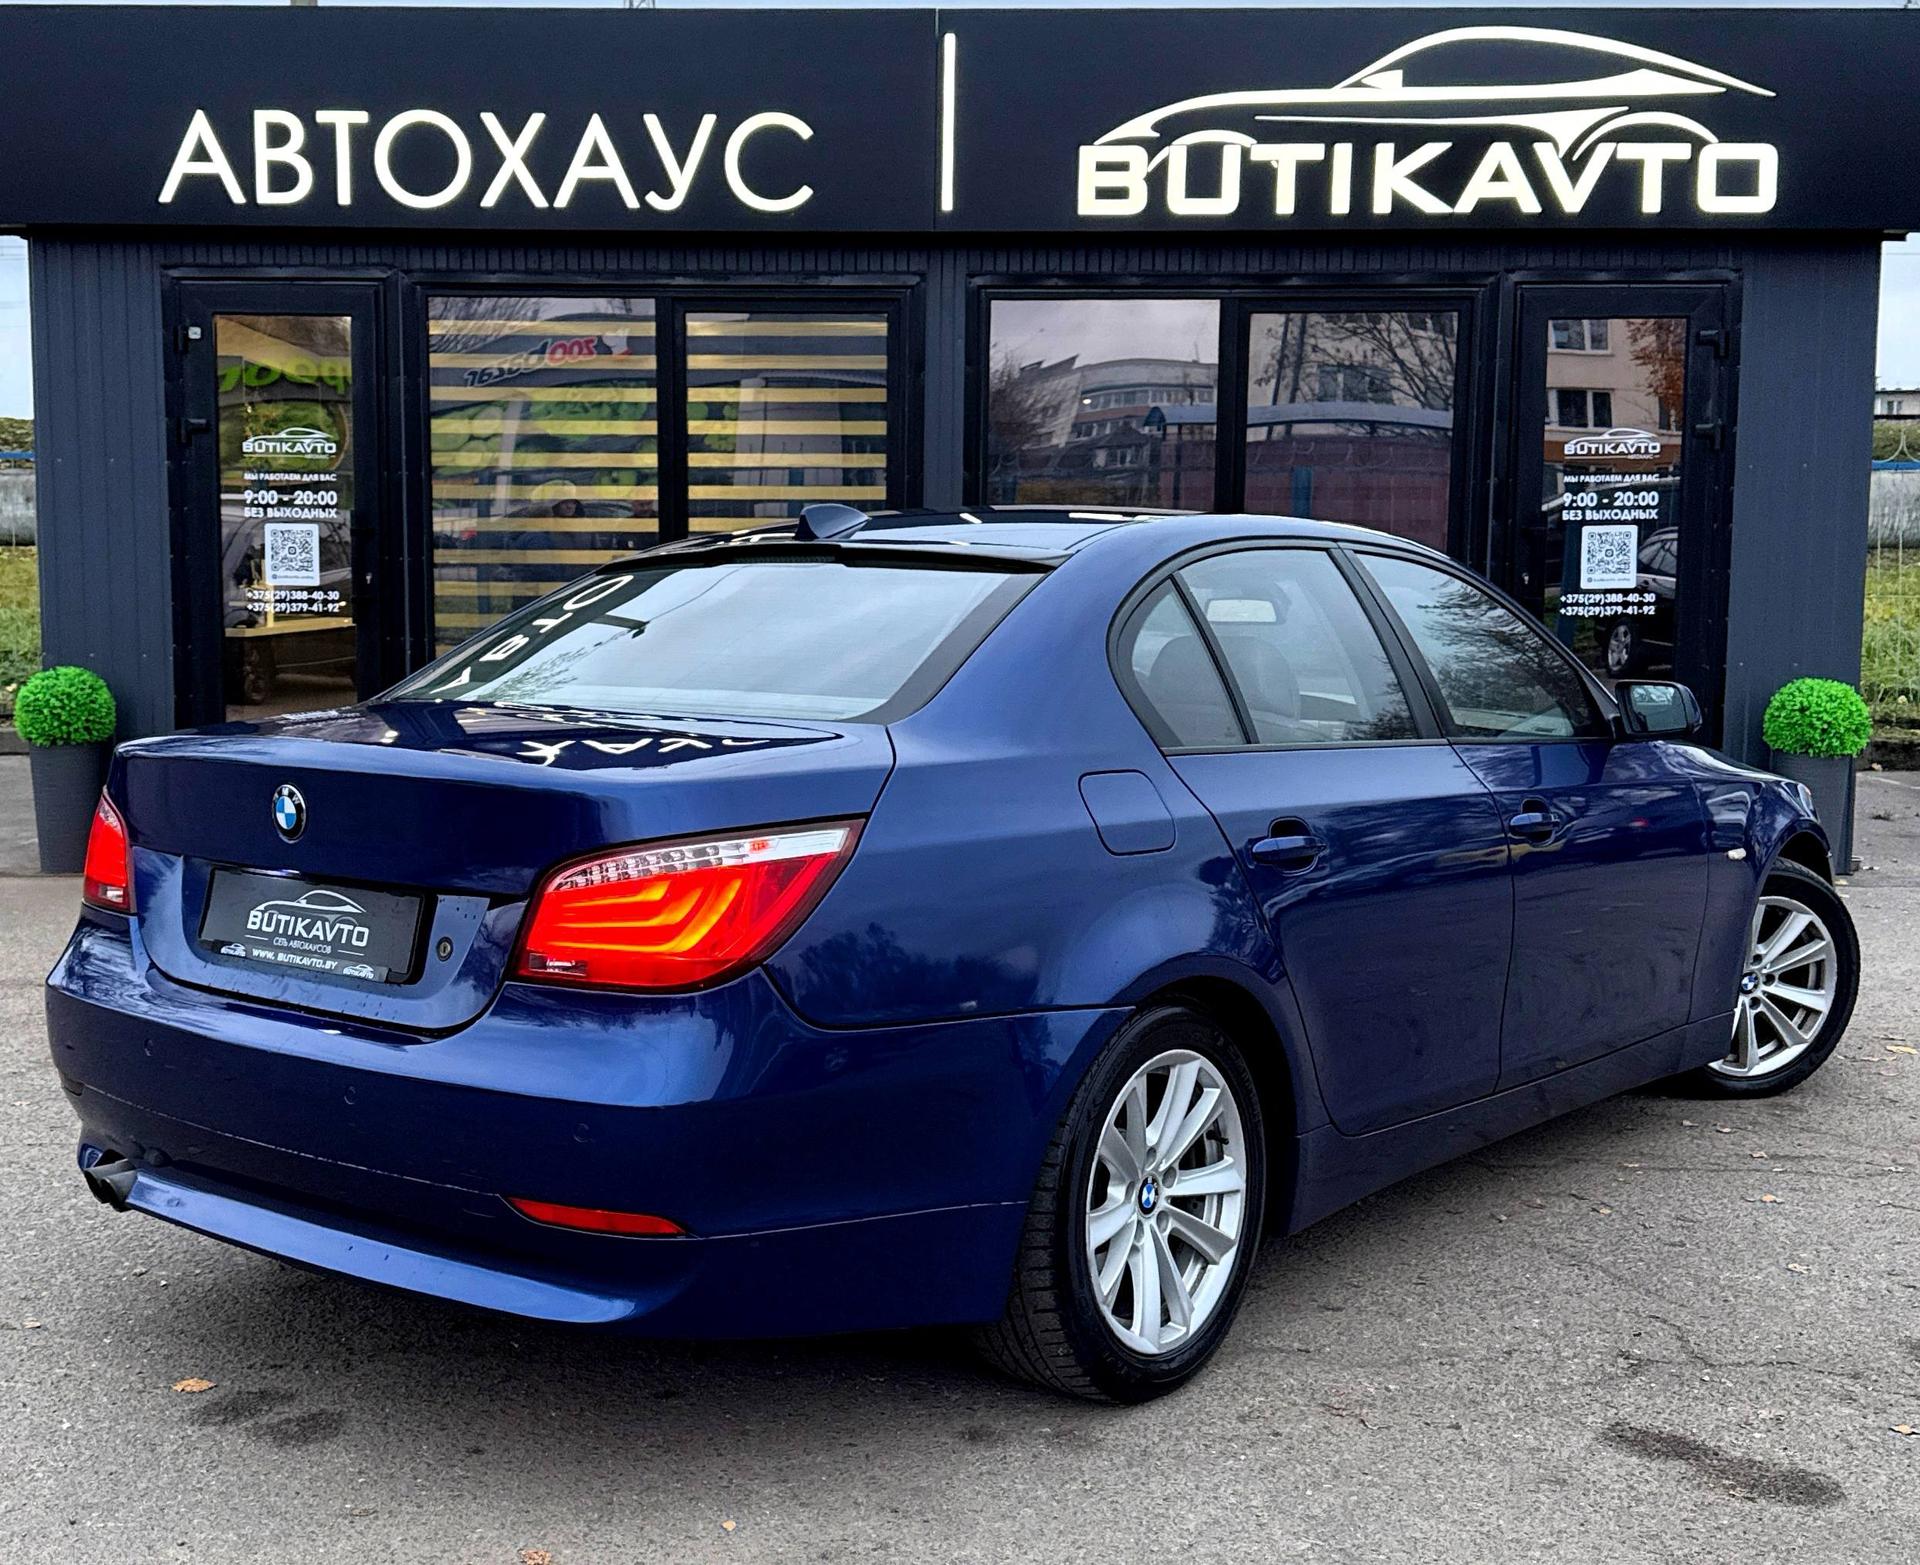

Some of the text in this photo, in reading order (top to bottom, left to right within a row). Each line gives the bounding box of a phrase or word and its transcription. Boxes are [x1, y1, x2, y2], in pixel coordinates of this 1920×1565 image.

[158, 109, 814, 213] АВТОХАУС
[1076, 140, 1779, 216] BUTIKAVTO
[242, 441, 337, 454] BUTIKAVTO
[1563, 443, 1661, 455] BUTIKAVTO
[1563, 473, 1660, 483] МЫ РАБОТАЕМ ДЛЯ ВАС
[243, 490, 279, 505] 9:00
[293, 491, 338, 505] 20:00
[1562, 492, 1598, 507] 9:00
[1613, 491, 1660, 507] 20:00
[244, 507, 338, 519] БЕЗ ВЫХОДНЫХ
[1561, 509, 1659, 521] БЕЗ ВЫХОДНЫХ
[246, 590, 340, 601] +375(29)388-40-30
[1560, 593, 1656, 605] +375(29)388-40-30
[246, 602, 340, 613] +375(29)379-41-92
[1559, 605, 1656, 617] +375(29)379-41-92
[246, 909, 370, 947] BUTIKAVTO
[252, 948, 338, 970] WWW. BUTIKAVTO.BY
